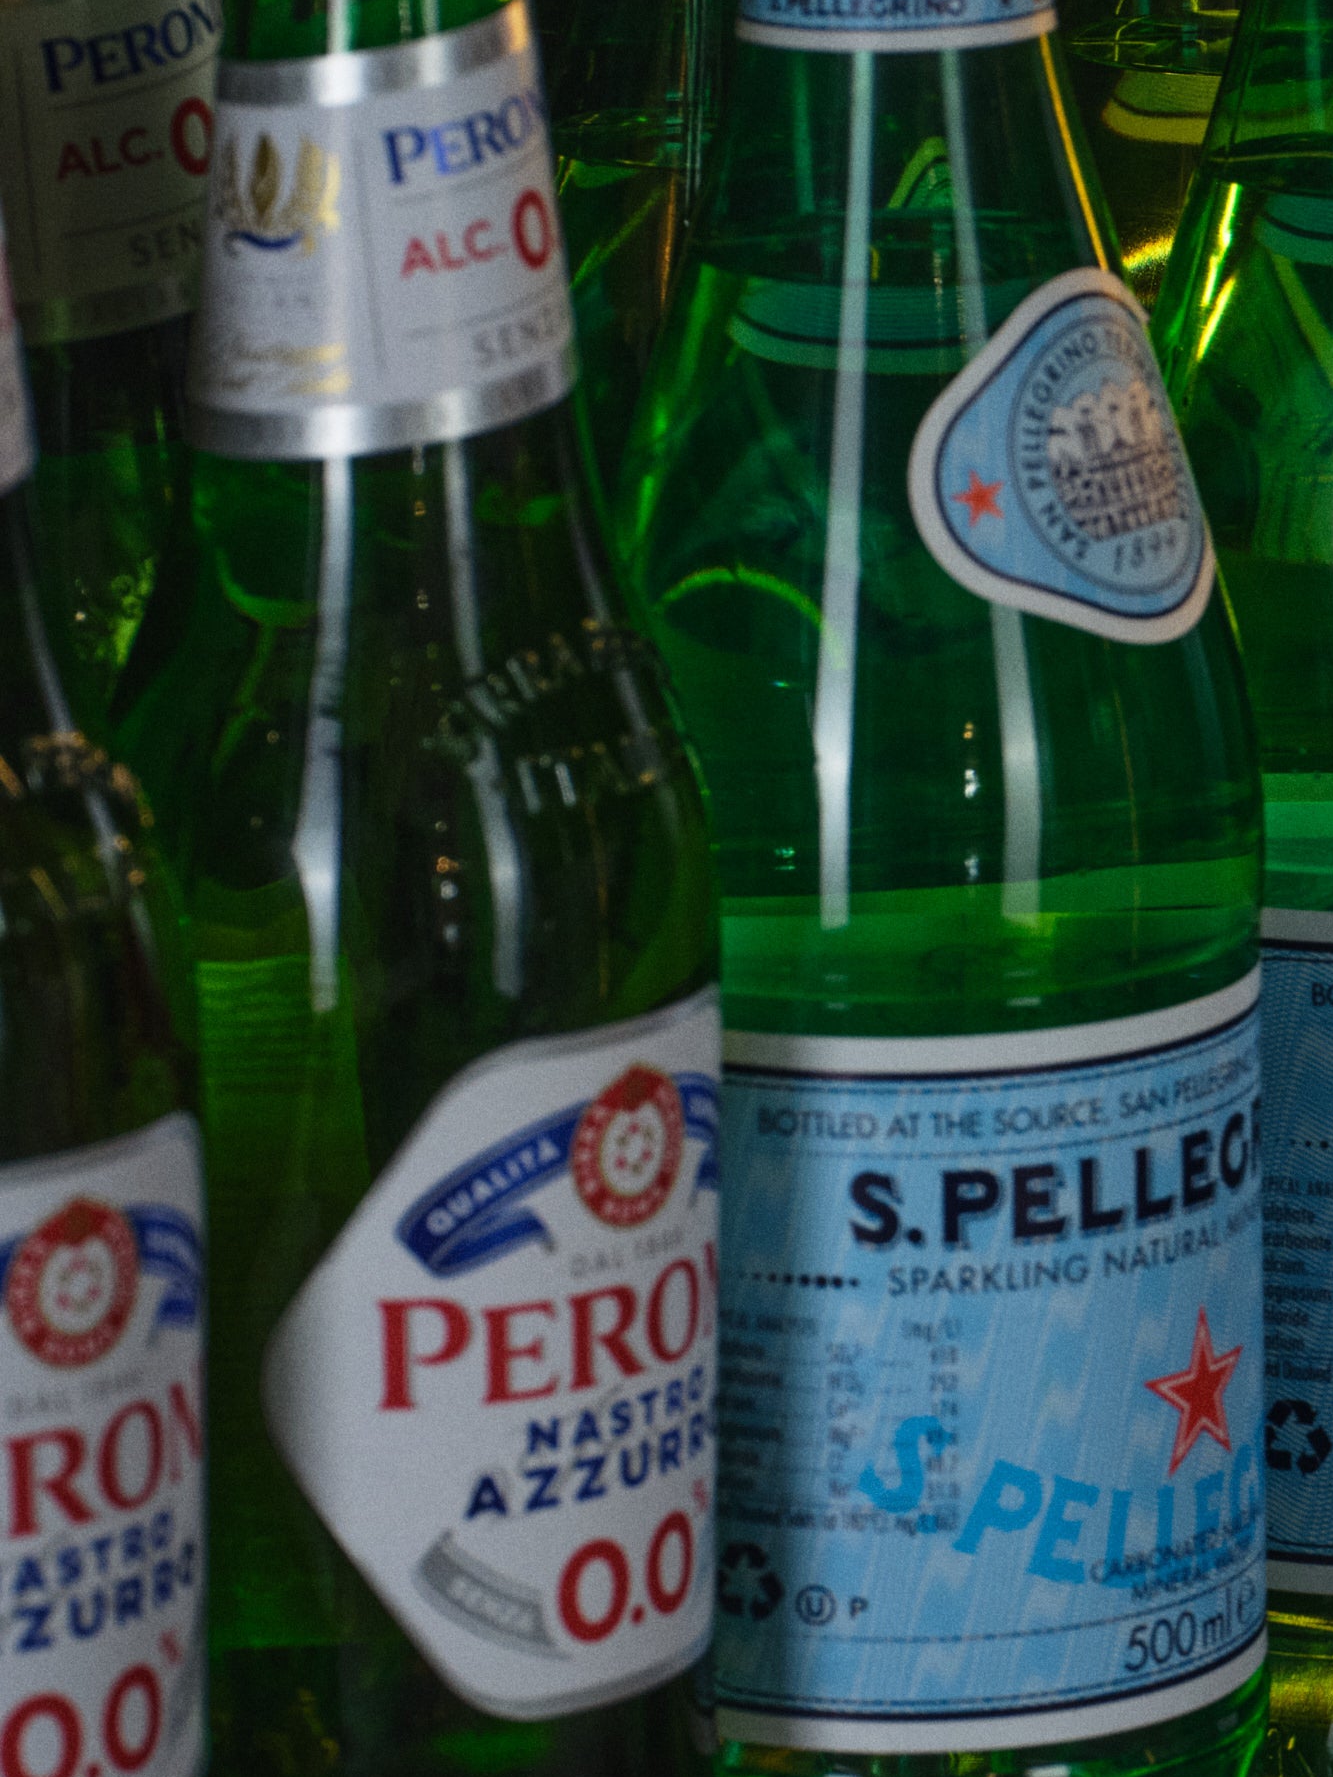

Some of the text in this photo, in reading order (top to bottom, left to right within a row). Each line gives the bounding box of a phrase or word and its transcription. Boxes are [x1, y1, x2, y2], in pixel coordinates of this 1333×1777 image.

[401, 217, 508, 280] ALC.
[1022, 327, 1098, 492] PELLEGRINO
[756, 1105, 878, 1140] BOTTLED
[887, 1111, 920, 1139] AT
[931, 1110, 983, 1139] THE
[1118, 1083, 1167, 1119] SAN
[887, 1228, 1222, 1297] SPARKLING NATURAL
[557, 1508, 695, 1644] 0.0
